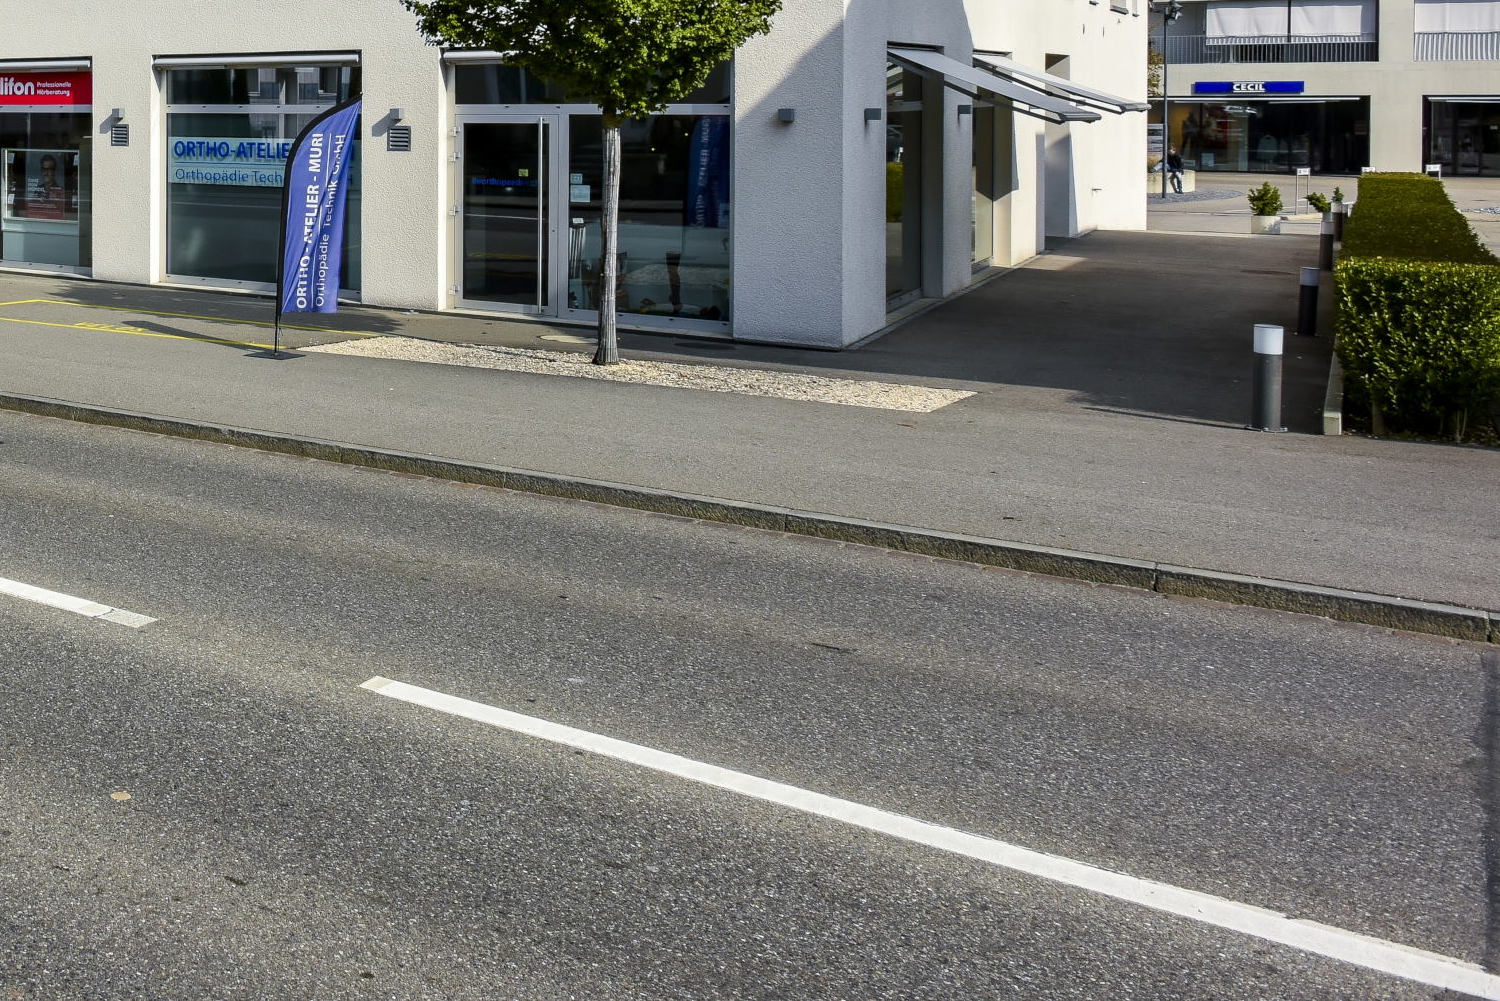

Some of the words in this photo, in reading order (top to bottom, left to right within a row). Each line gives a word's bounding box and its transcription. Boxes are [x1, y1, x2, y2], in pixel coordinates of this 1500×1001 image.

[36, 89, 70, 97] Hörberatung
[1232, 83, 1266, 91] CECIL
[173, 140, 292, 161] ORTHO-ATELIE
[308, 133, 324, 173] MURI
[175, 167, 249, 183] Orthopädie
[251, 169, 283, 184] Tech
[303, 184, 320, 244] ATELIER
[315, 234, 329, 307] Orthopädie
[323, 181, 338, 229] Technik
[296, 256, 311, 309] ORTHO
